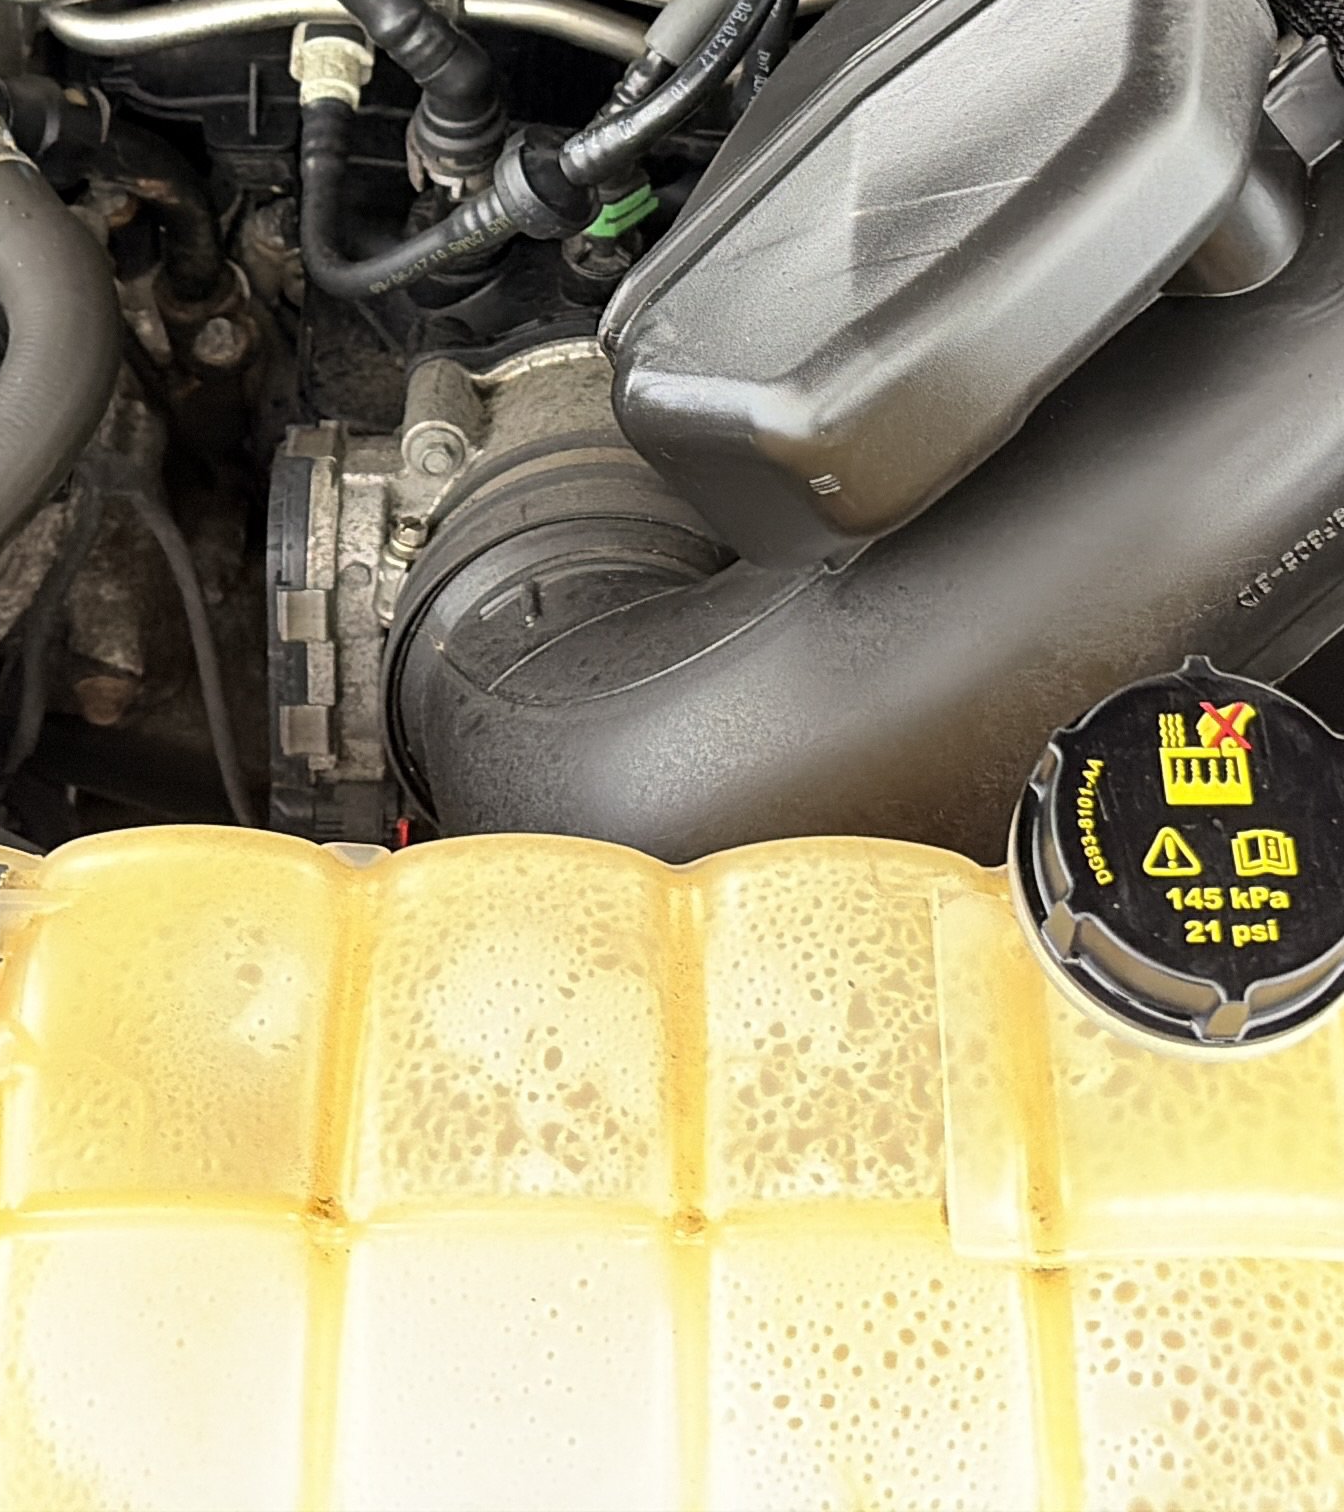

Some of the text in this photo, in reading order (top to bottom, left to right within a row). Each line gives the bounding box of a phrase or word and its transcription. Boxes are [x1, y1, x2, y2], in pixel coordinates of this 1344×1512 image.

[1075, 757, 1114, 887] DG93-8101-AA
[1165, 886, 1290, 911] 145 kPa
[1183, 920, 1281, 948] 21 psi
